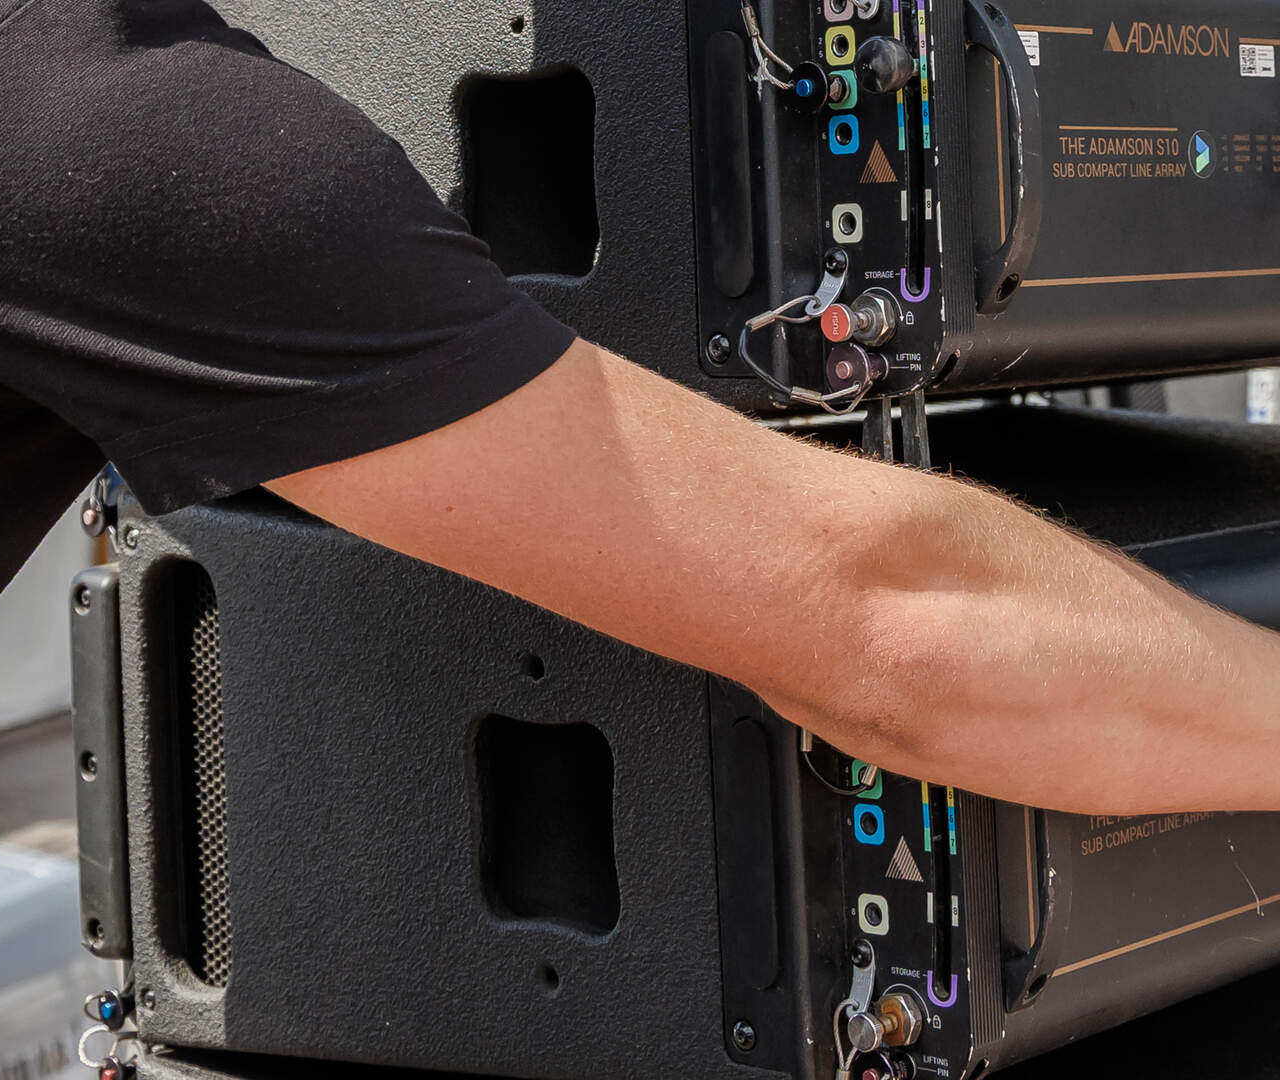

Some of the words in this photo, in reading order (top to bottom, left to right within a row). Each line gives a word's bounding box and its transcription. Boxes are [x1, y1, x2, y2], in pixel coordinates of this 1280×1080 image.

[1124, 22, 1230, 57] ADAMSON
[1058, 136, 1086, 155] THE
[1089, 137, 1154, 156] ADAMSON
[1156, 138, 1180, 156] S10
[1052, 162, 1075, 178] SUB
[1077, 162, 1128, 178] COMPACT
[1129, 163, 1153, 177] LINE
[1155, 163, 1187, 177] ARRAY
[864, 270, 895, 280] STORAGE
[832, 311, 840, 336] PUSH
[895, 353, 921, 361] LIFTING
[910, 363, 922, 372] PIN
[1081, 836, 1104, 856] SUB
[1105, 820, 1156, 849] COMPACT
[1157, 813, 1182, 833] LINE
[890, 966, 921, 979] STORAGE
[923, 1055, 949, 1067] LIFTING
[937, 1067, 949, 1078] PIN
